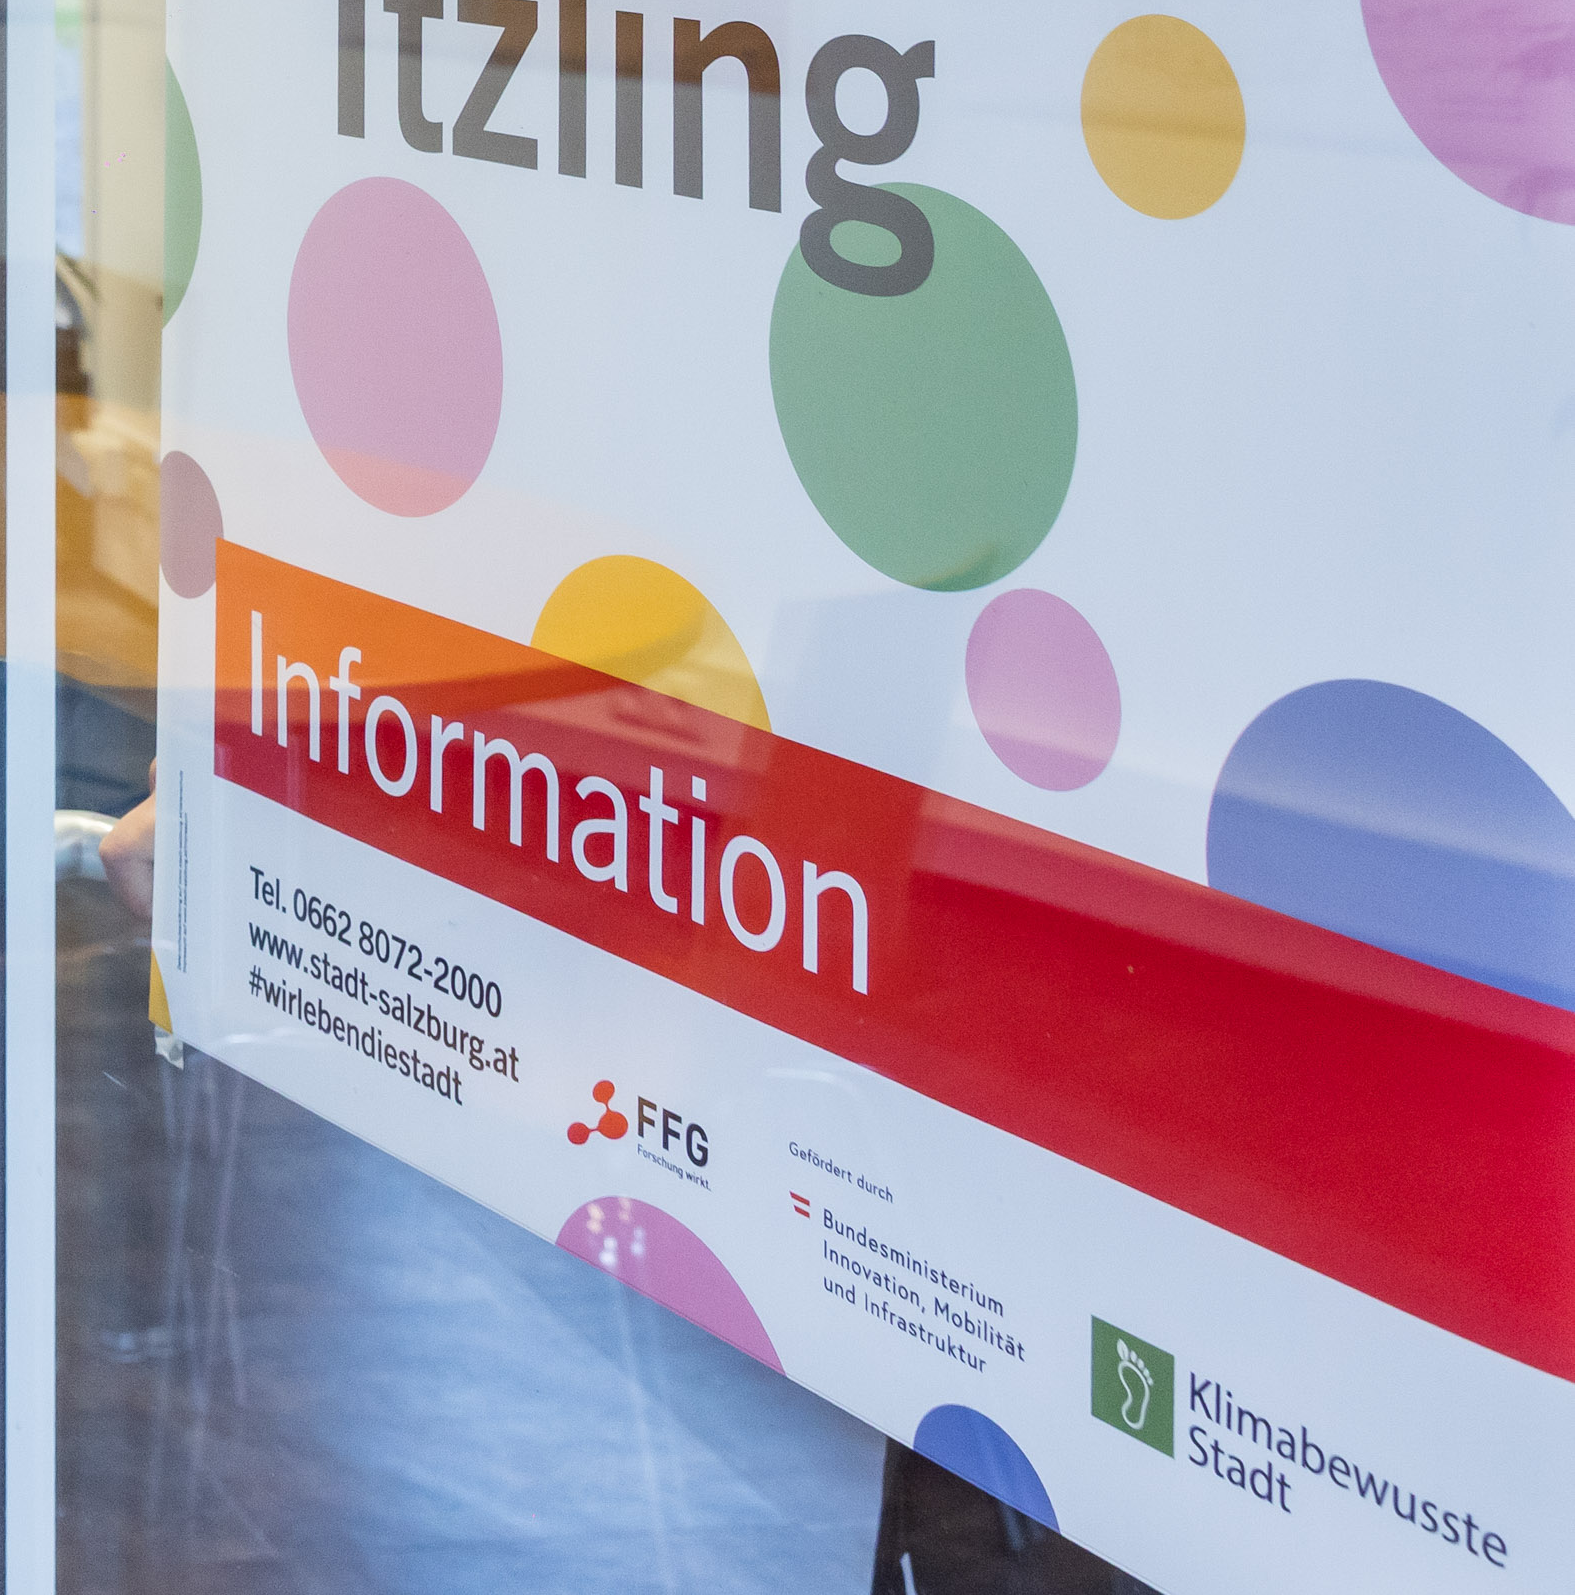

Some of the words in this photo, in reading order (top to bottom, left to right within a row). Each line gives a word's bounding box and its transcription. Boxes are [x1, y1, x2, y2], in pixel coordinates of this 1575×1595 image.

[250, 609, 869, 996] Information
[249, 921, 520, 1083] www.stadt-salzburg.at
[250, 865, 287, 913] Tel.
[293, 888, 352, 947] 0662
[358, 920, 502, 1018] 8072-2000
[249, 964, 463, 1106] #wirlebendiestadt
[637, 1095, 709, 1168] FFG
[789, 1141, 853, 1184] Gefördert
[857, 1175, 894, 1204] durch
[823, 1208, 1004, 1318] Bundesministerium
[823, 1240, 926, 1314] Innovation,
[934, 1296, 1026, 1363] Mobilität
[823, 1276, 856, 1305] und
[864, 1292, 988, 1374] Infrastruktur
[1187, 1425, 1292, 1514] Stadt
[1189, 1370, 1508, 1569] Klimabewusste
